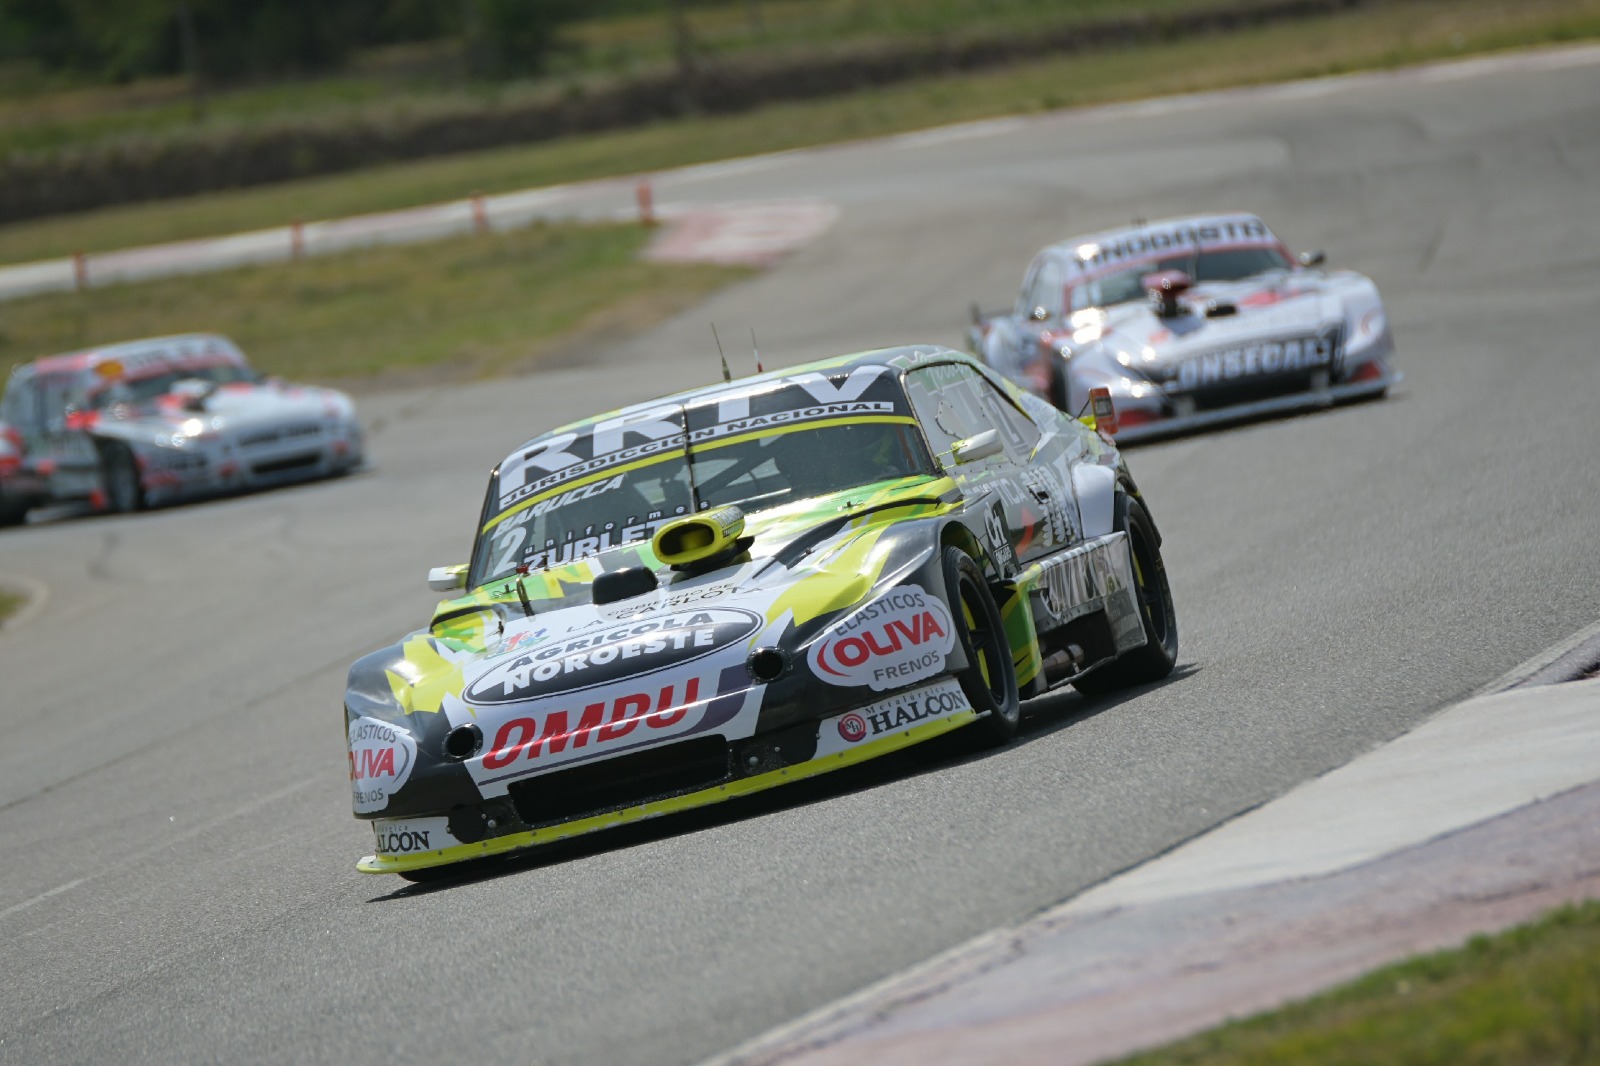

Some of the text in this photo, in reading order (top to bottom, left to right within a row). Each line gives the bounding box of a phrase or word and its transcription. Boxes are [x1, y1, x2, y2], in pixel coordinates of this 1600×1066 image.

[503, 428, 714, 505] JURISDICCION
[727, 403, 891, 432] NACIONAL
[492, 527, 527, 577] 2
[523, 514, 690, 571] ZURLET
[566, 587, 763, 633] LA CARLOTA
[834, 593, 925, 636] ELASTICOS
[503, 629, 714, 695] NOROESTE
[507, 613, 715, 671] AGRICOLA
[833, 611, 945, 667] OLIVA
[873, 651, 940, 681] FRENOS
[482, 677, 699, 770] OMDU
[867, 690, 967, 735] HALCON
[375, 831, 430, 852] ALCON
